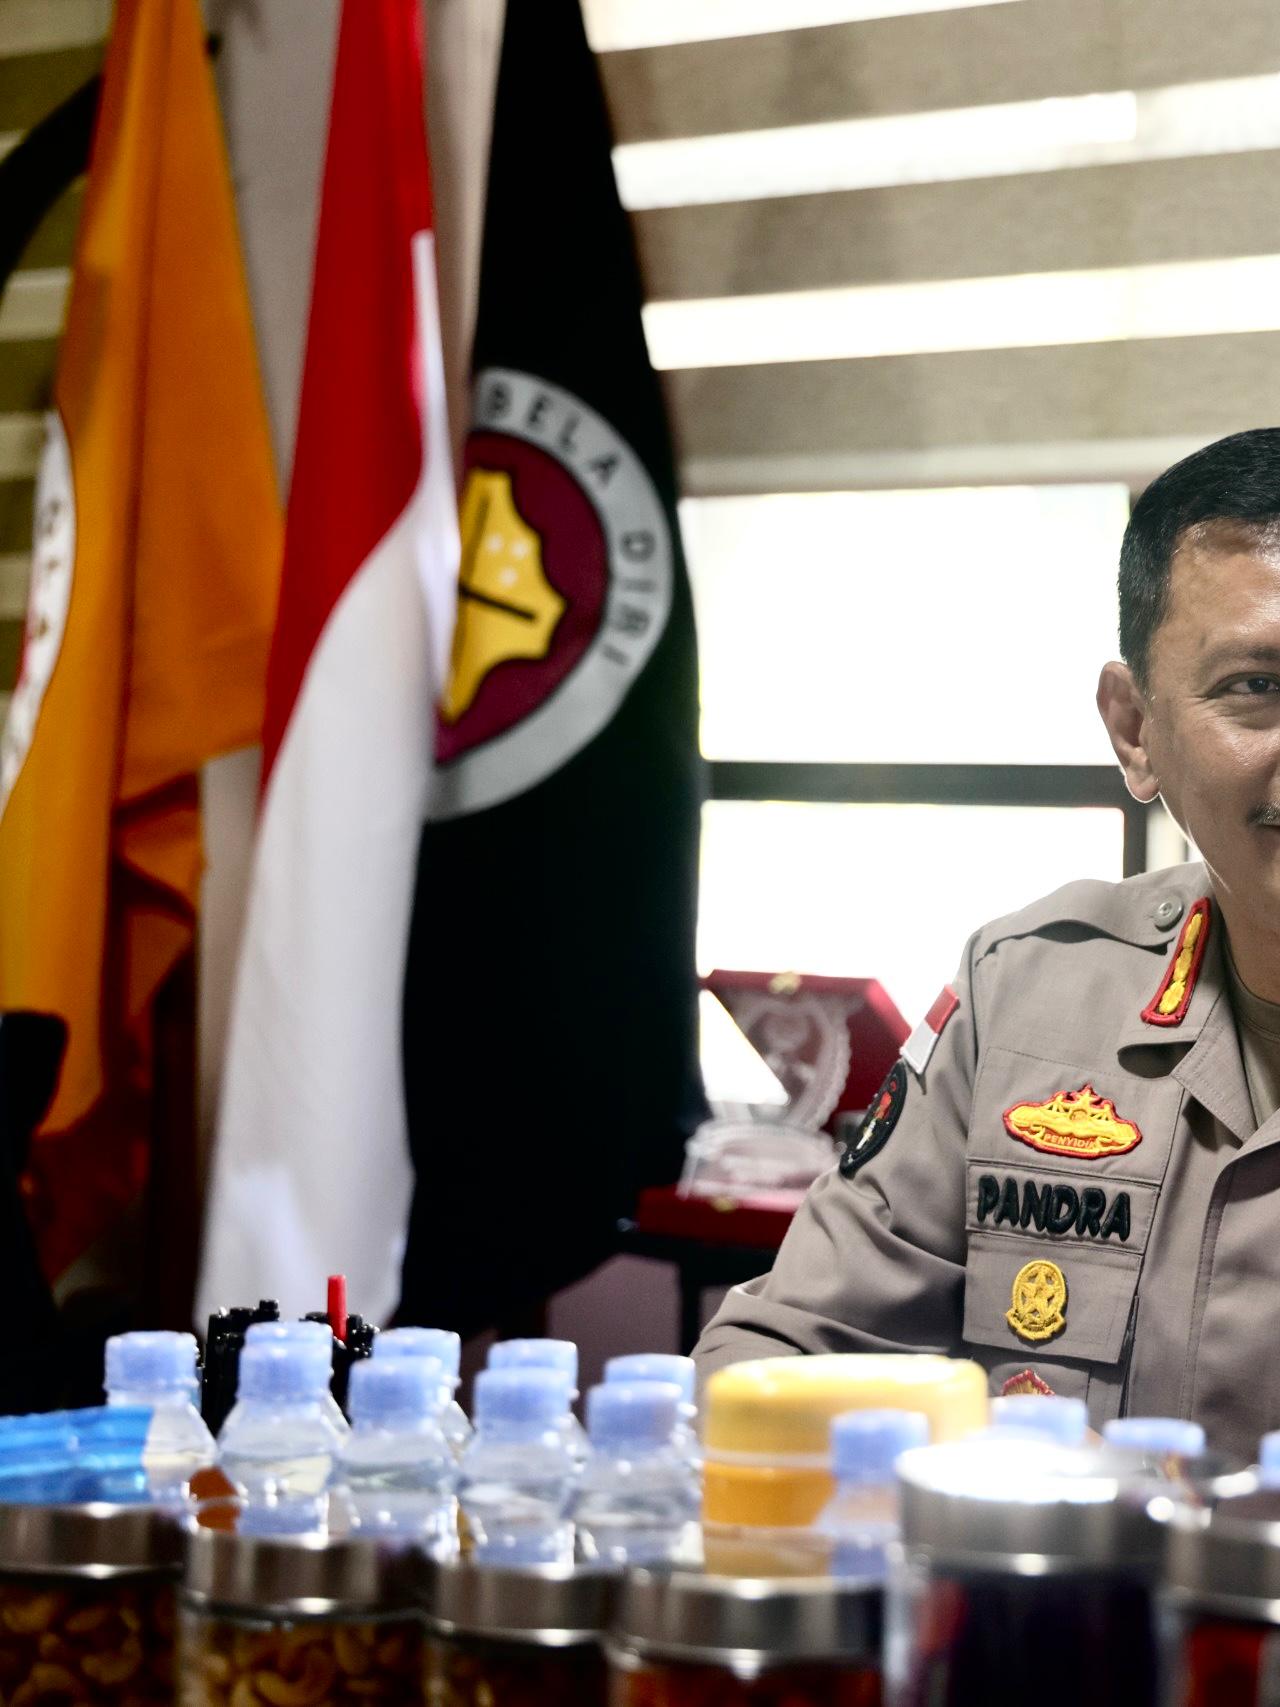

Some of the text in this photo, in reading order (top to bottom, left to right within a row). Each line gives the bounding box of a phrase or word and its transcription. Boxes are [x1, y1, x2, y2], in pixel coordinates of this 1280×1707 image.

[487, 381, 658, 665] BELA DIRI
[976, 1174, 1132, 1242] PANDRA
